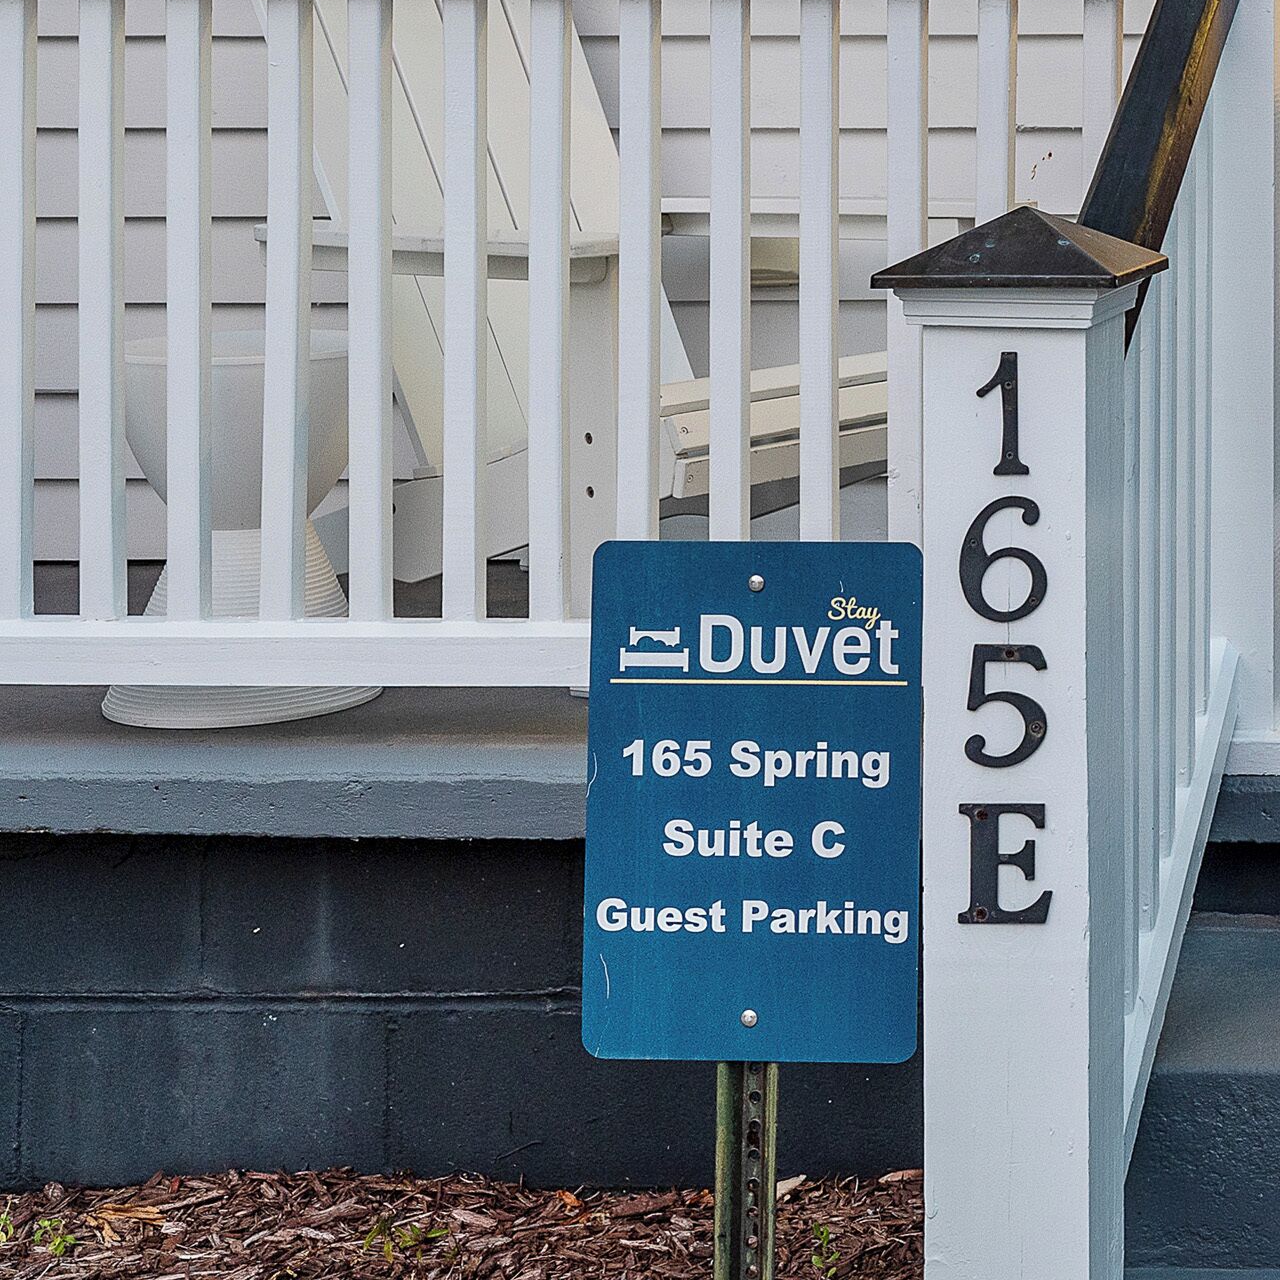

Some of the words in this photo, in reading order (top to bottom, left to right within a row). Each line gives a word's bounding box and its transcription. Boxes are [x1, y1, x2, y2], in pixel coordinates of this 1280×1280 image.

[827, 596, 881, 630] Stay
[699, 614, 899, 675] Duvet
[958, 351, 1053, 924] 165E
[622, 740, 712, 778] 165
[729, 740, 891, 788] Spring
[662, 819, 793, 858] Suite
[811, 820, 846, 859] C
[596, 897, 726, 934] Guest
[742, 899, 910, 945] Parking
